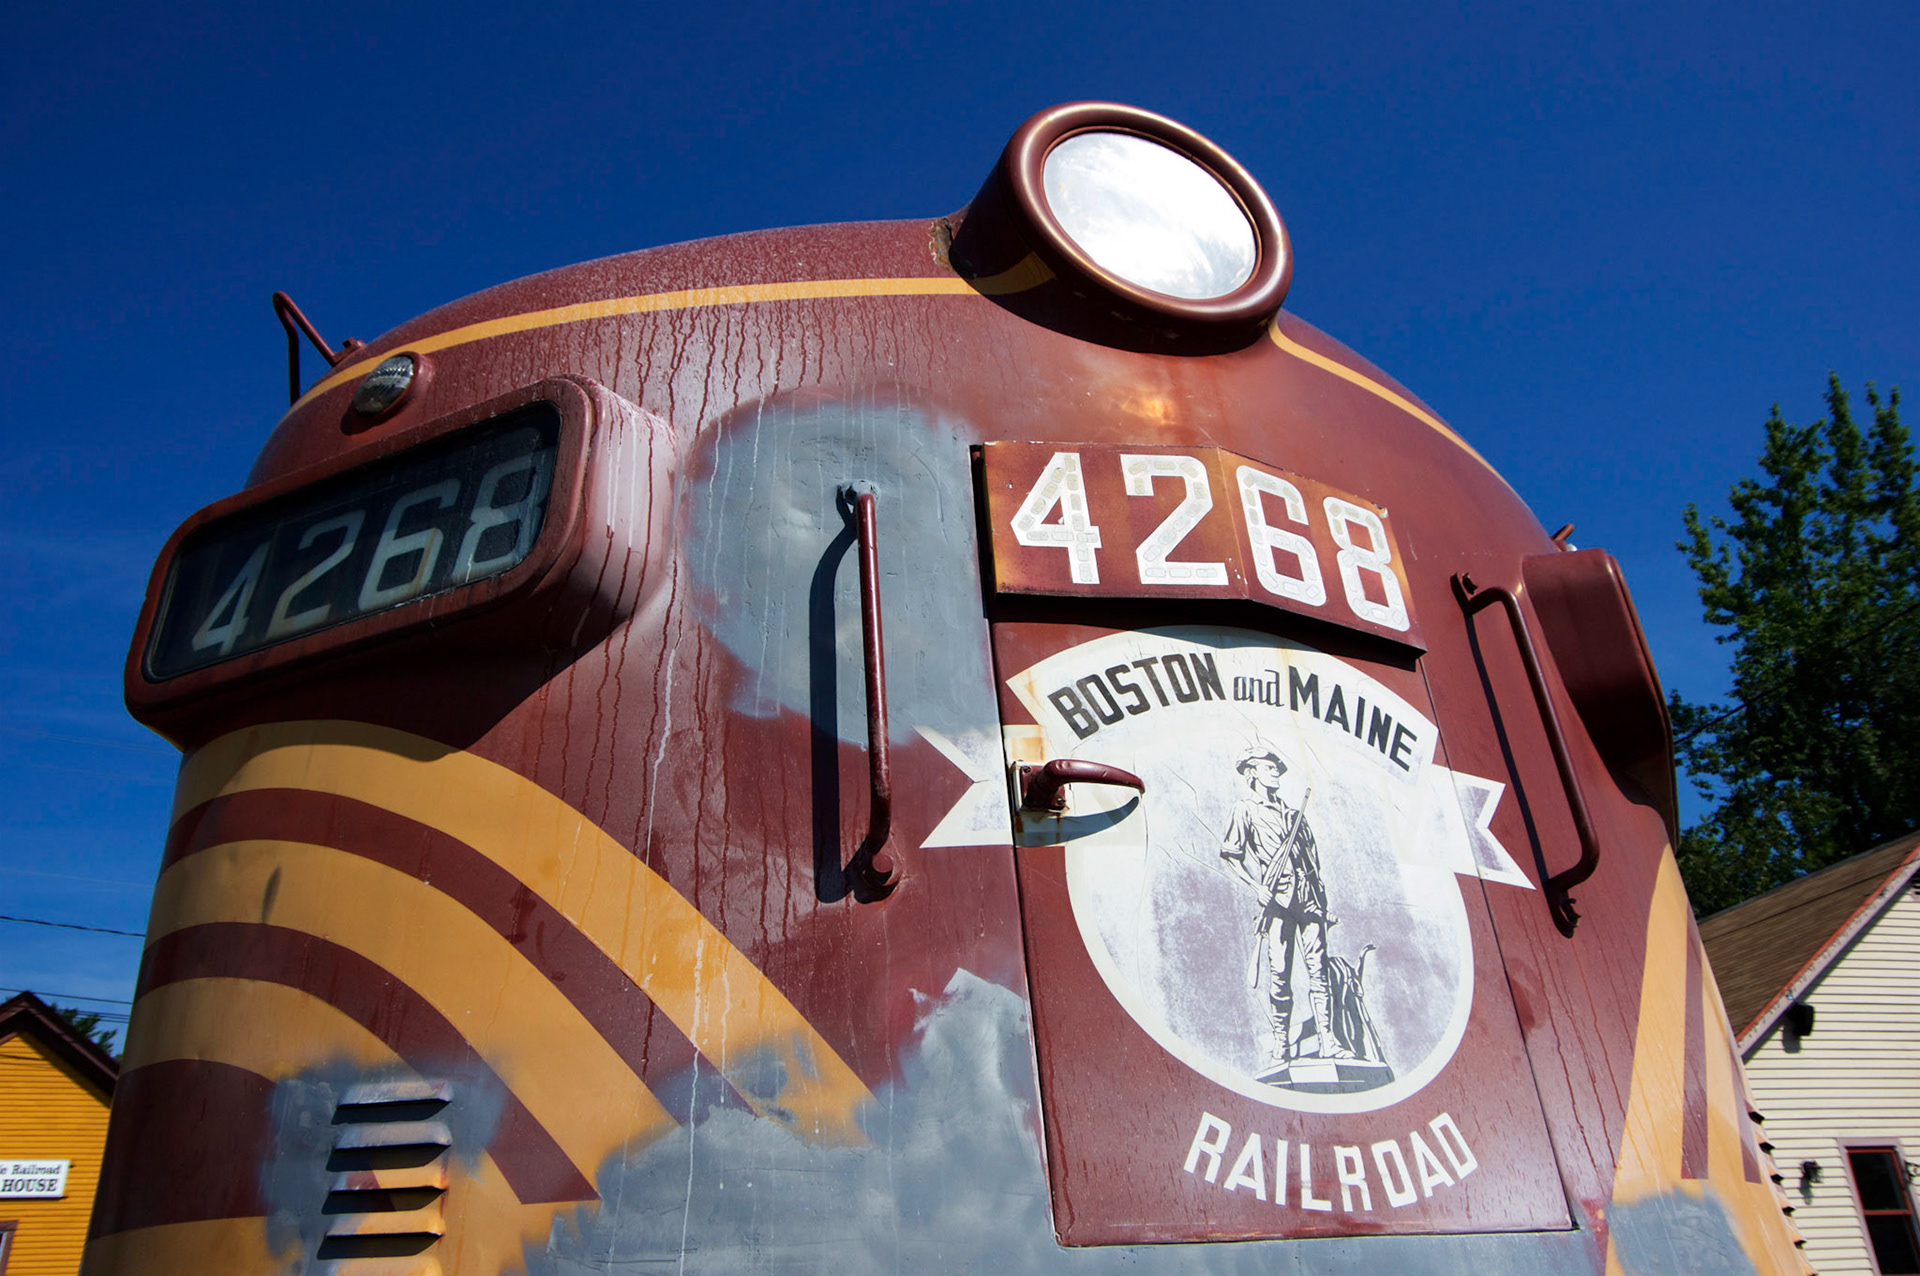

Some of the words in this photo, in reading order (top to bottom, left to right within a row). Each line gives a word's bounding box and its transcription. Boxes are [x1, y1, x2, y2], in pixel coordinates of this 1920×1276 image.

[193, 448, 546, 656] 4268
[1010, 452, 1411, 632] 4268
[1047, 652, 1226, 740] BOSTON
[1233, 669, 1285, 707] and
[1288, 665, 1417, 772] MAINE
[1, 1178, 58, 1192] HOUSE
[12, 1164, 61, 1175] Railroad
[1183, 1111, 1478, 1213] RAILROAD
